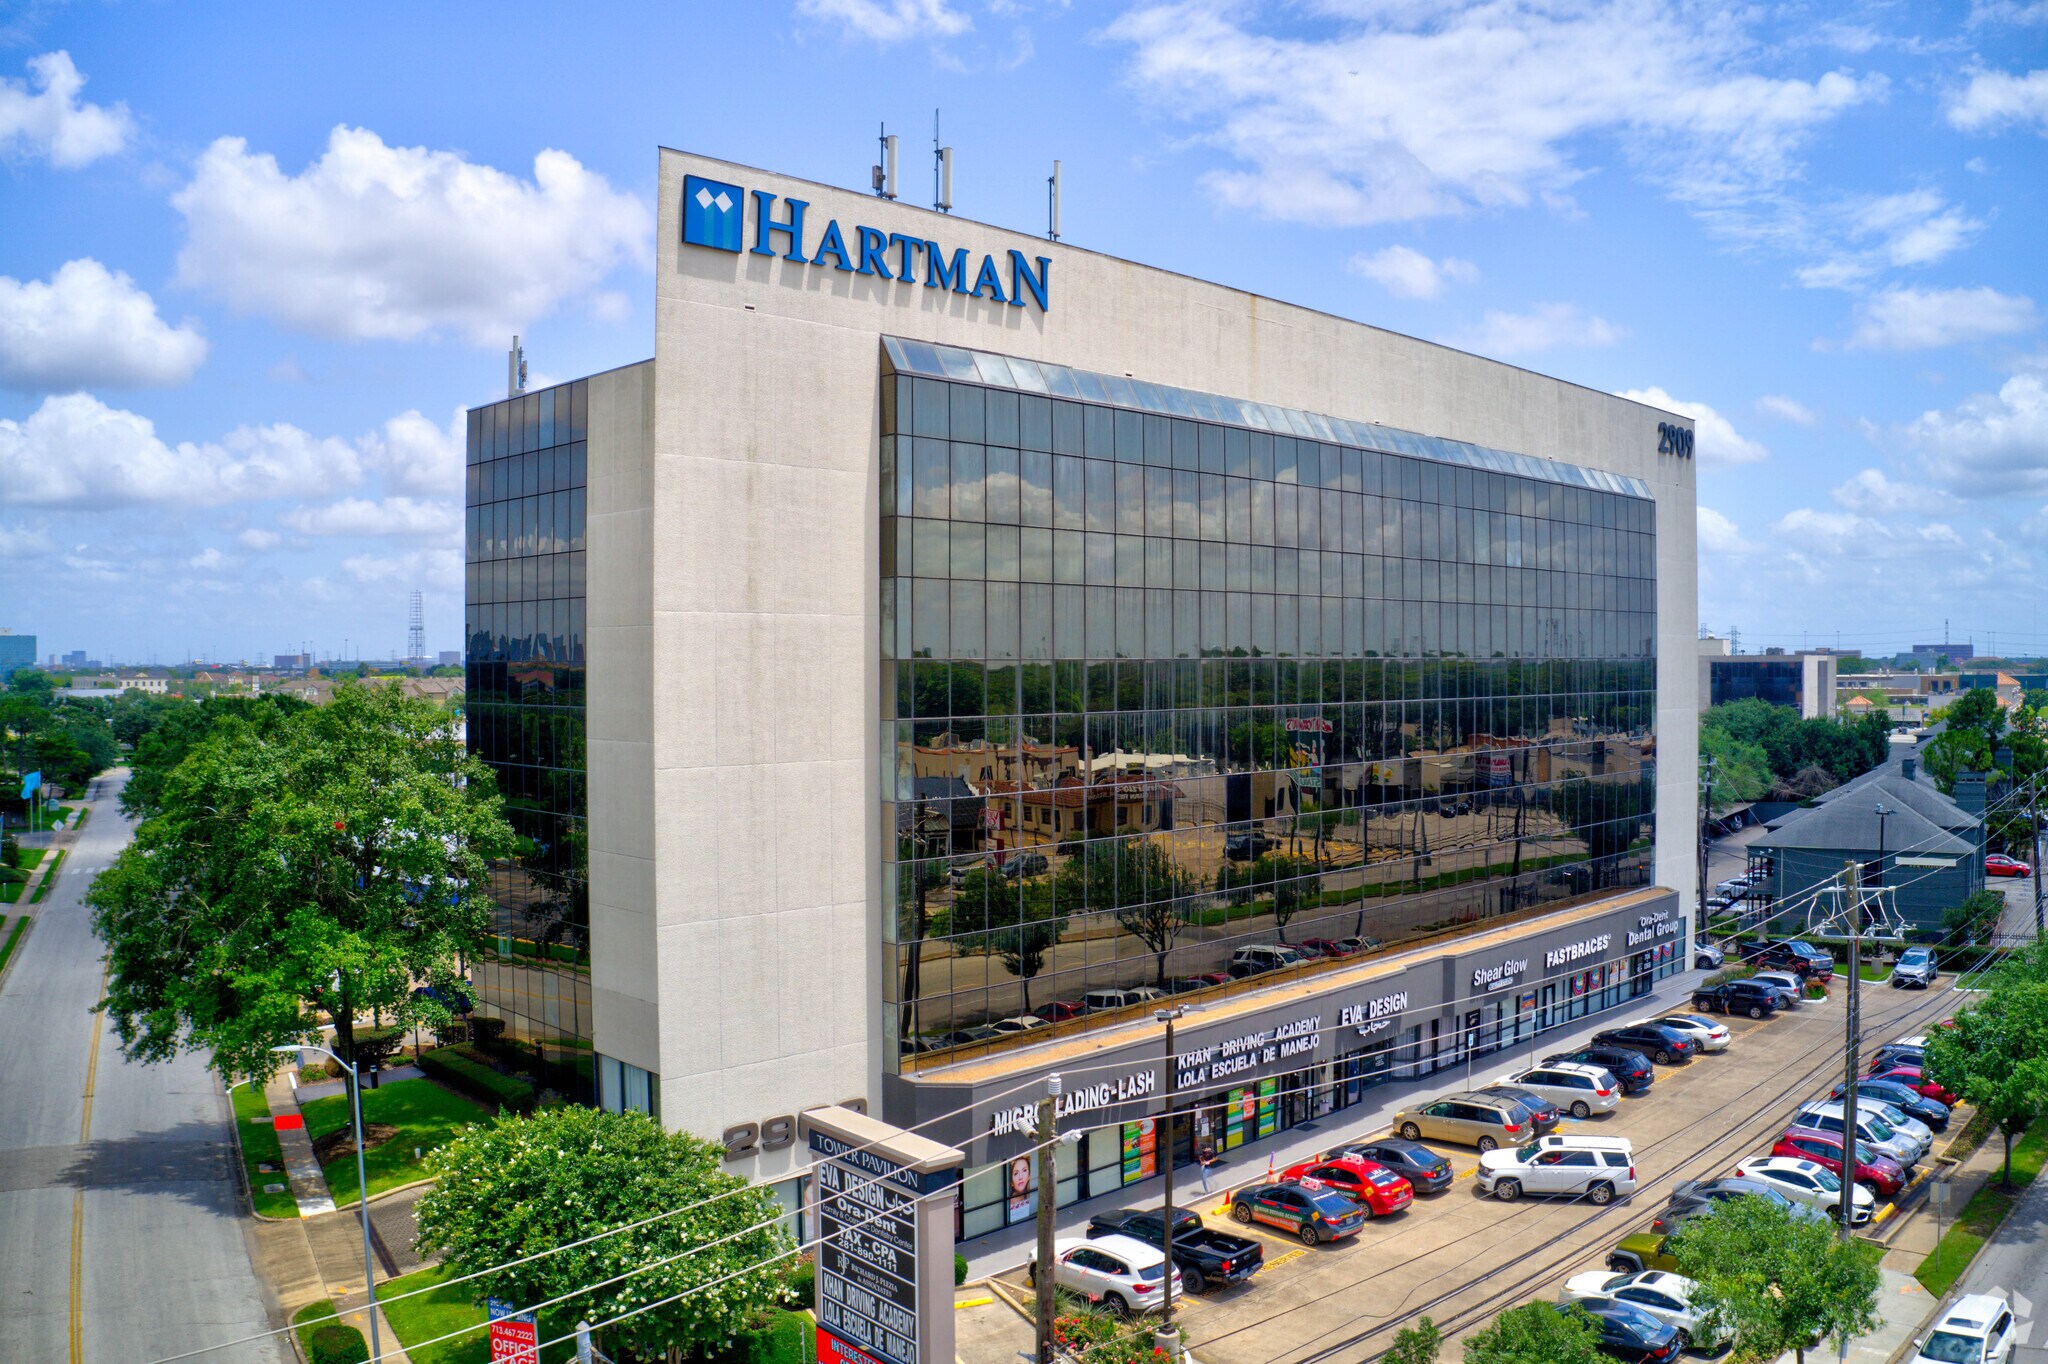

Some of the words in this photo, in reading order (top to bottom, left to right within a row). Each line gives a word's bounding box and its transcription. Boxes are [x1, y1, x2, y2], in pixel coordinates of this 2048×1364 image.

[750, 189, 1052, 312] HARTMAN
[1657, 421, 1694, 460] 2909
[1628, 925, 1655, 947] Dental
[1656, 920, 1679, 937] Group
[1640, 910, 1669, 927] Ora-Dent
[1473, 966, 1503, 986] Shear
[1503, 958, 1528, 977] Glow
[1341, 1004, 1363, 1027] EVA
[1369, 991, 1408, 1019] DESIGN
[1177, 1047, 1211, 1070] KHAN
[1222, 1032, 1264, 1057] DRIVING
[1275, 1016, 1320, 1041] ACADEMY
[1177, 1067, 1206, 1090] LOLA
[1211, 1052, 1257, 1079] ESCUELA
[1262, 1047, 1276, 1063] DE
[1280, 1034, 1320, 1058] MANEJO
[817, 1134, 860, 1164] TOWER
[862, 1152, 918, 1188] PAVILION
[820, 1162, 840, 1190] EVA
[844, 1171, 884, 1210] DESIGN
[822, 1203, 839, 1217] Family
[870, 1225, 893, 1242] Dentistry
[893, 1236, 913, 1250] Center
[837, 1197, 897, 1235] Ora-Dent
[837, 1224, 862, 1246] TAX
[872, 1241, 897, 1263] CPA
[838, 1238, 897, 1273] 281-890-1111
[851, 1263, 876, 1281] RICHARD
[880, 1277, 898, 1293] PLEZIA
[862, 1278, 892, 1298] ASSOCIATES
[490, 1308, 505, 1317] NOW
[824, 1272, 844, 1302] KHAN
[846, 1284, 876, 1318] DRIVING
[879, 1300, 914, 1338] ACADEMY
[492, 1338, 535, 1358] OFFICE
[824, 1299, 841, 1328] LOLA
[842, 1309, 872, 1345] ESCUELA
[874, 1326, 884, 1351] DE
[886, 1332, 915, 1364] MANEJO
